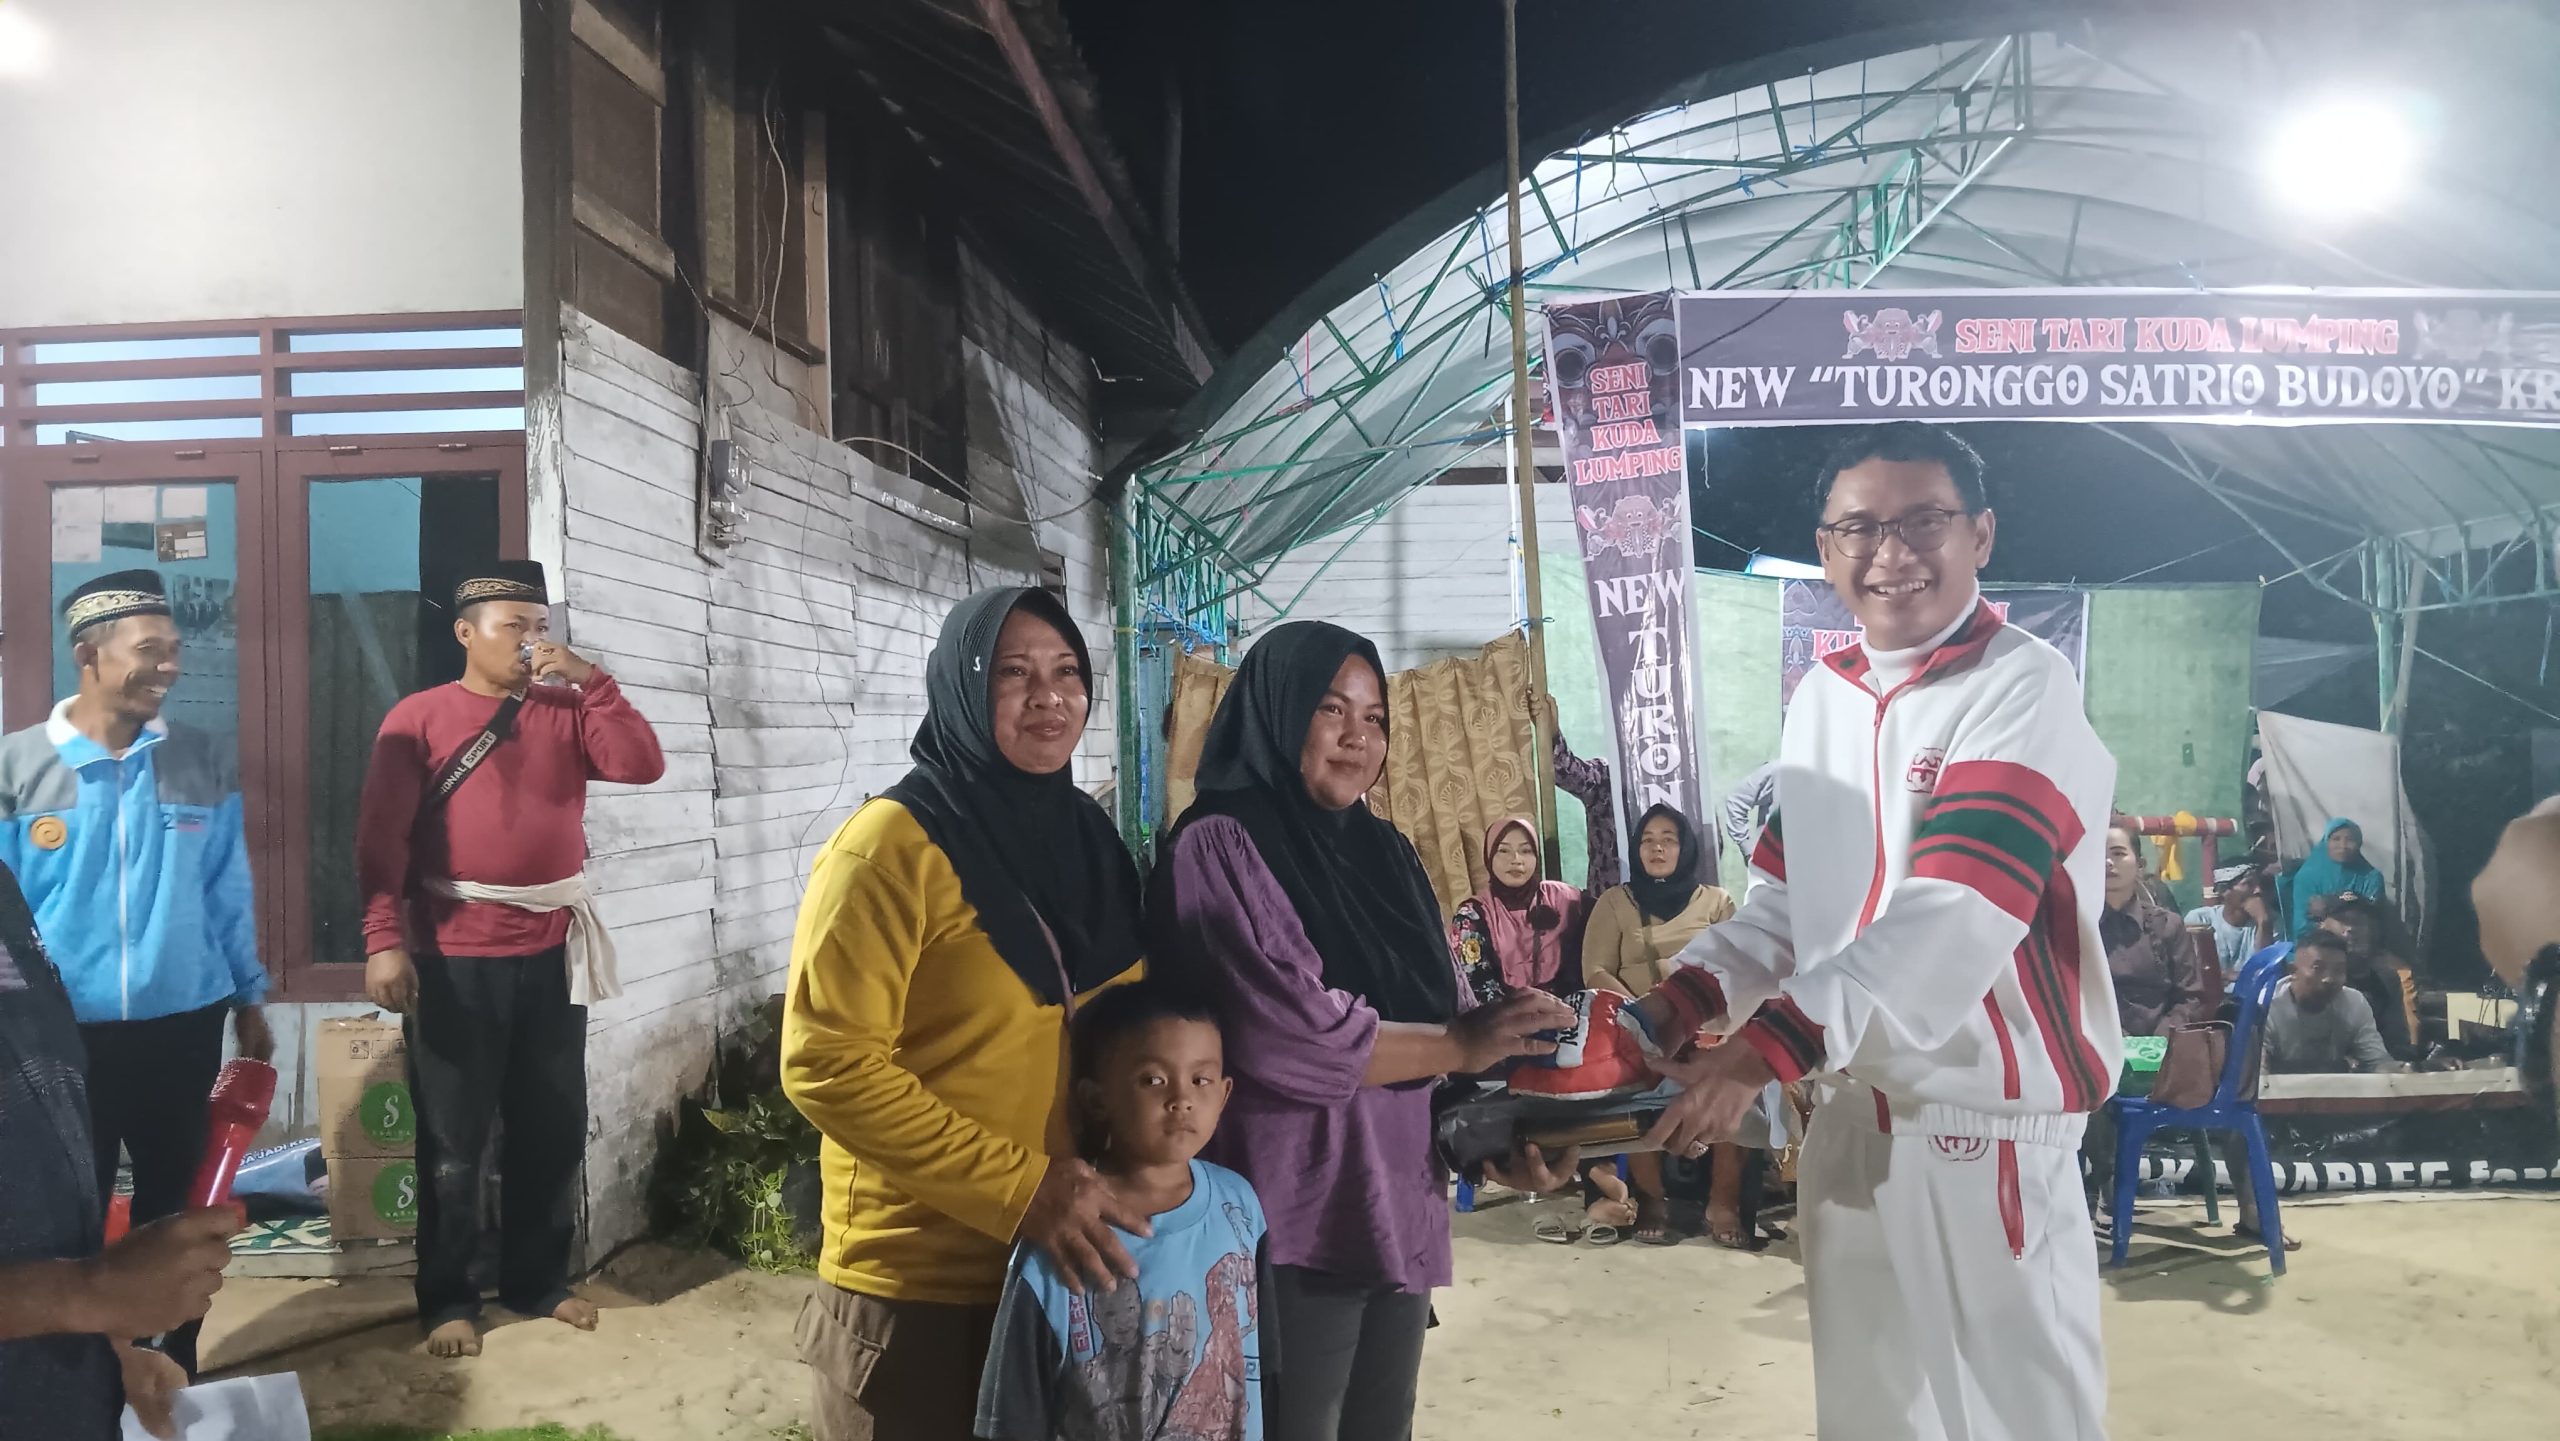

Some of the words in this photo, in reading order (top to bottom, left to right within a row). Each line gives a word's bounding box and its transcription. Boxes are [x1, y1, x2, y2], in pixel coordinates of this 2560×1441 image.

[1955, 318, 2036, 353] SENI
[2043, 317, 2127, 353] TARI
[2134, 317, 2233, 353] KUDA
[2239, 314, 2400, 355] LUMPING
[1589, 363, 1648, 393] SENI
[1688, 365, 1797, 410] NEW
[2100, 363, 2266, 406] SATRIO
[1592, 391, 1652, 423] TARI
[1590, 419, 1661, 452] KUDA
[1573, 446, 1681, 486] LUMPING
[1594, 567, 1684, 618] NEW
[465, 731, 496, 764] SPORT
